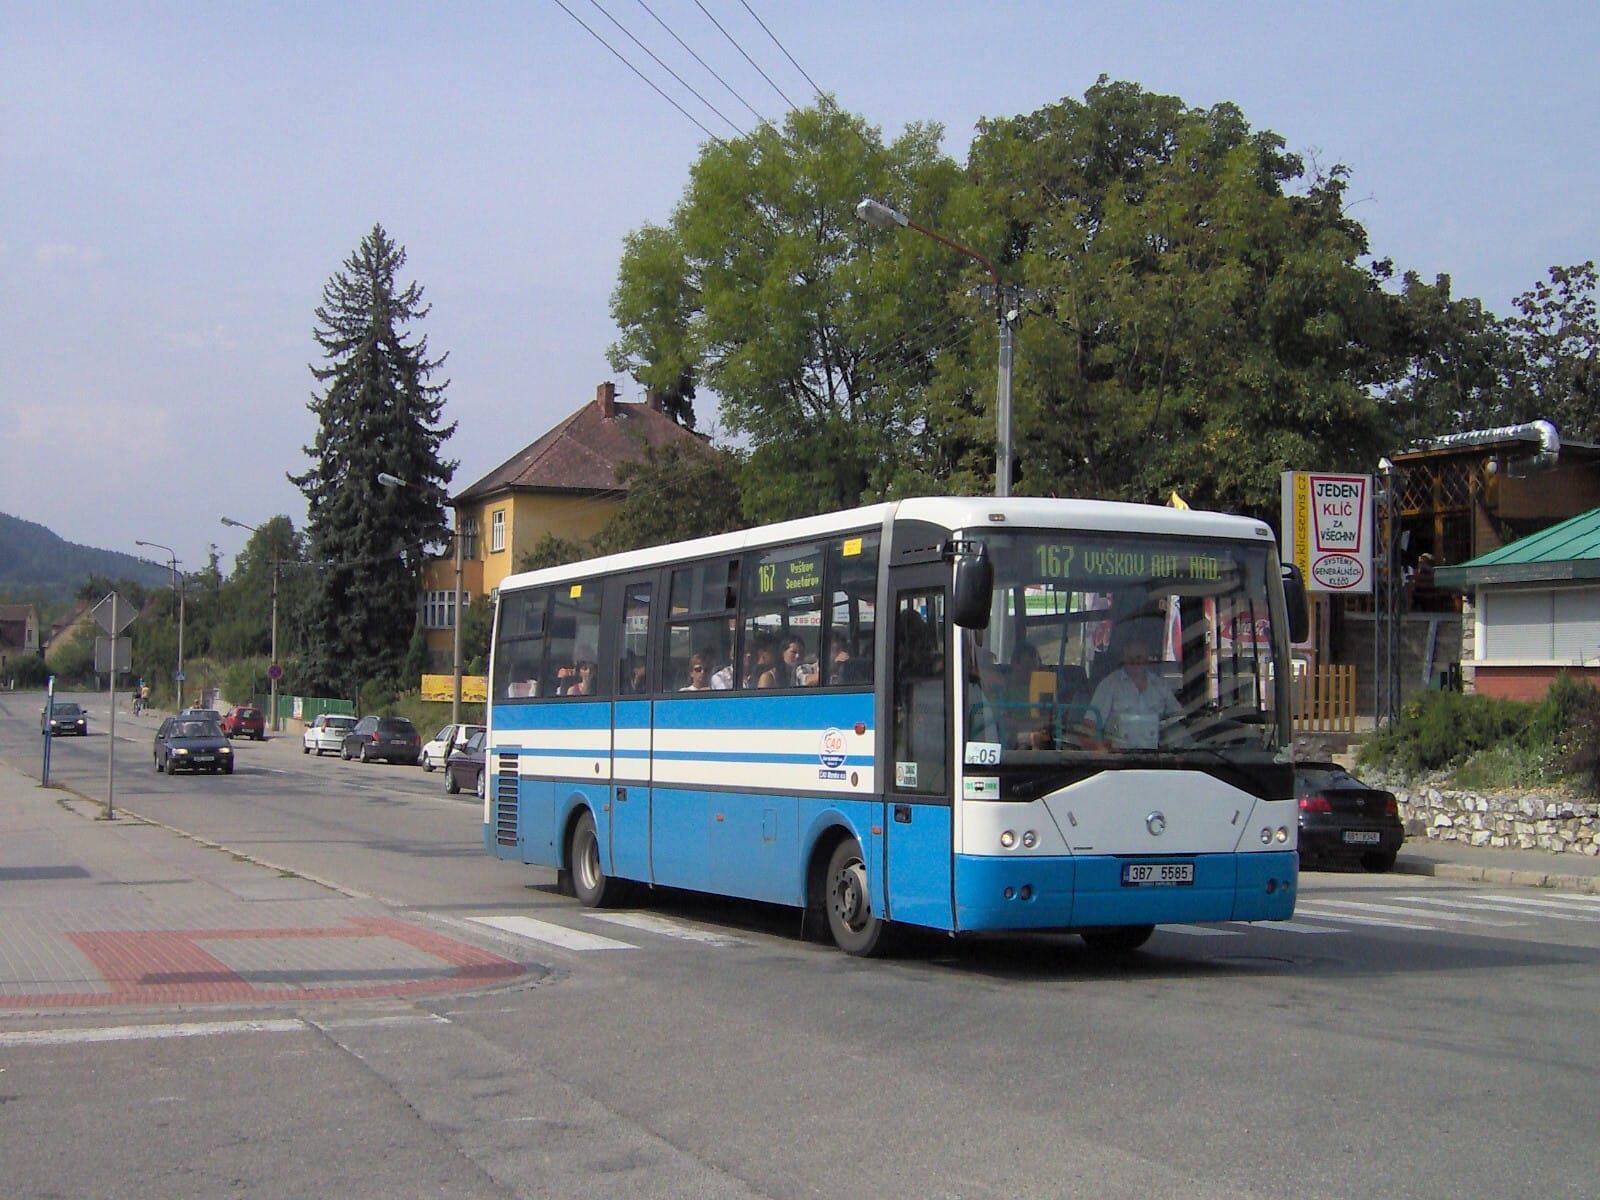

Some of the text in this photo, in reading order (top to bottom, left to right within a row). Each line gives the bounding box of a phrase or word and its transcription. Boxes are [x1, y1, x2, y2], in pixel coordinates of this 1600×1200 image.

[1317, 484, 1358, 498] JEDEN
[1323, 502, 1352, 516] KLÍČ
[1333, 520, 1343, 528] ZA
[1320, 529, 1356, 541] VŠECHNY
[1036, 544, 1075, 578] 167
[1085, 548, 1144, 576] VYŠKOV
[1151, 554, 1184, 578] AUT.
[759, 564, 775, 592] 167
[980, 748, 997, 764] 05
[1132, 866, 1188, 880] 3B7 5585
